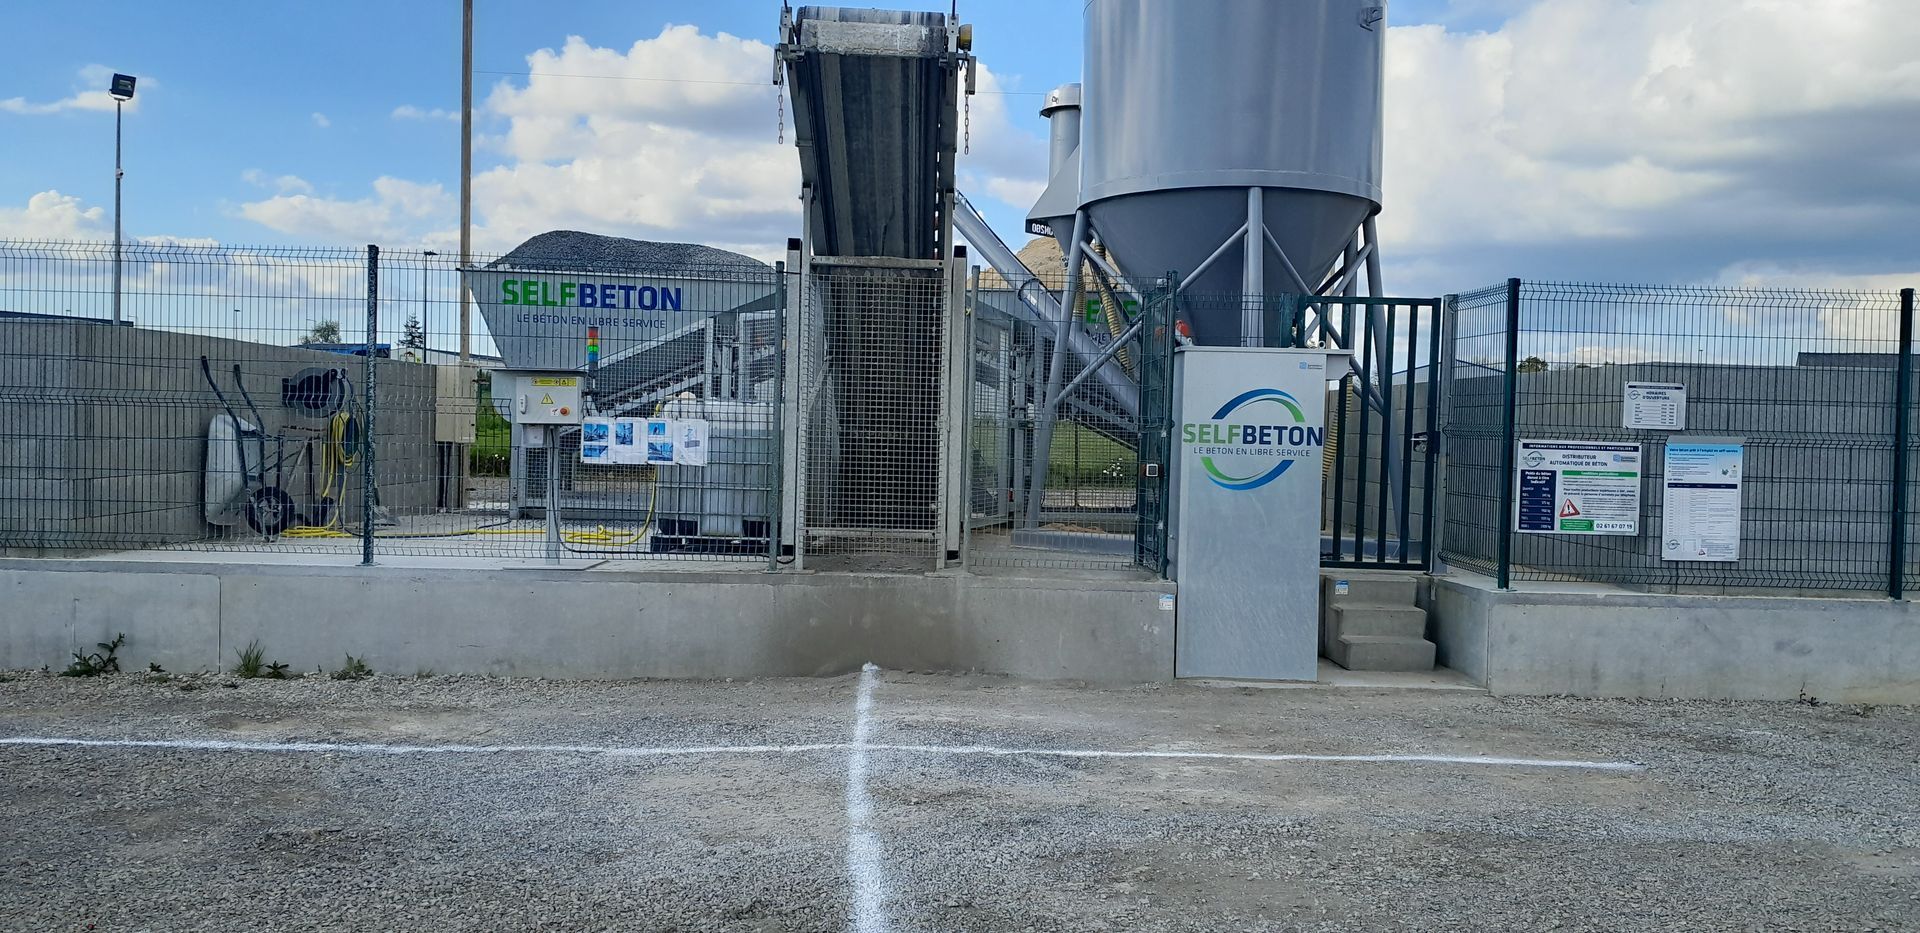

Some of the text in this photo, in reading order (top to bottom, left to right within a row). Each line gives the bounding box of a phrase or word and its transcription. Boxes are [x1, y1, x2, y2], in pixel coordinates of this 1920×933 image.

[502, 279, 682, 312] SELFBETON
[517, 313, 530, 323] LE
[571, 315, 585, 325] EN
[588, 316, 619, 328] LIBRE
[622, 318, 666, 329] SERVICE
[1182, 423, 1323, 447] SELFBETON
[1236, 447, 1247, 456] EN
[1250, 448, 1273, 457] LIBRE
[1276, 448, 1311, 457] SERVICE
